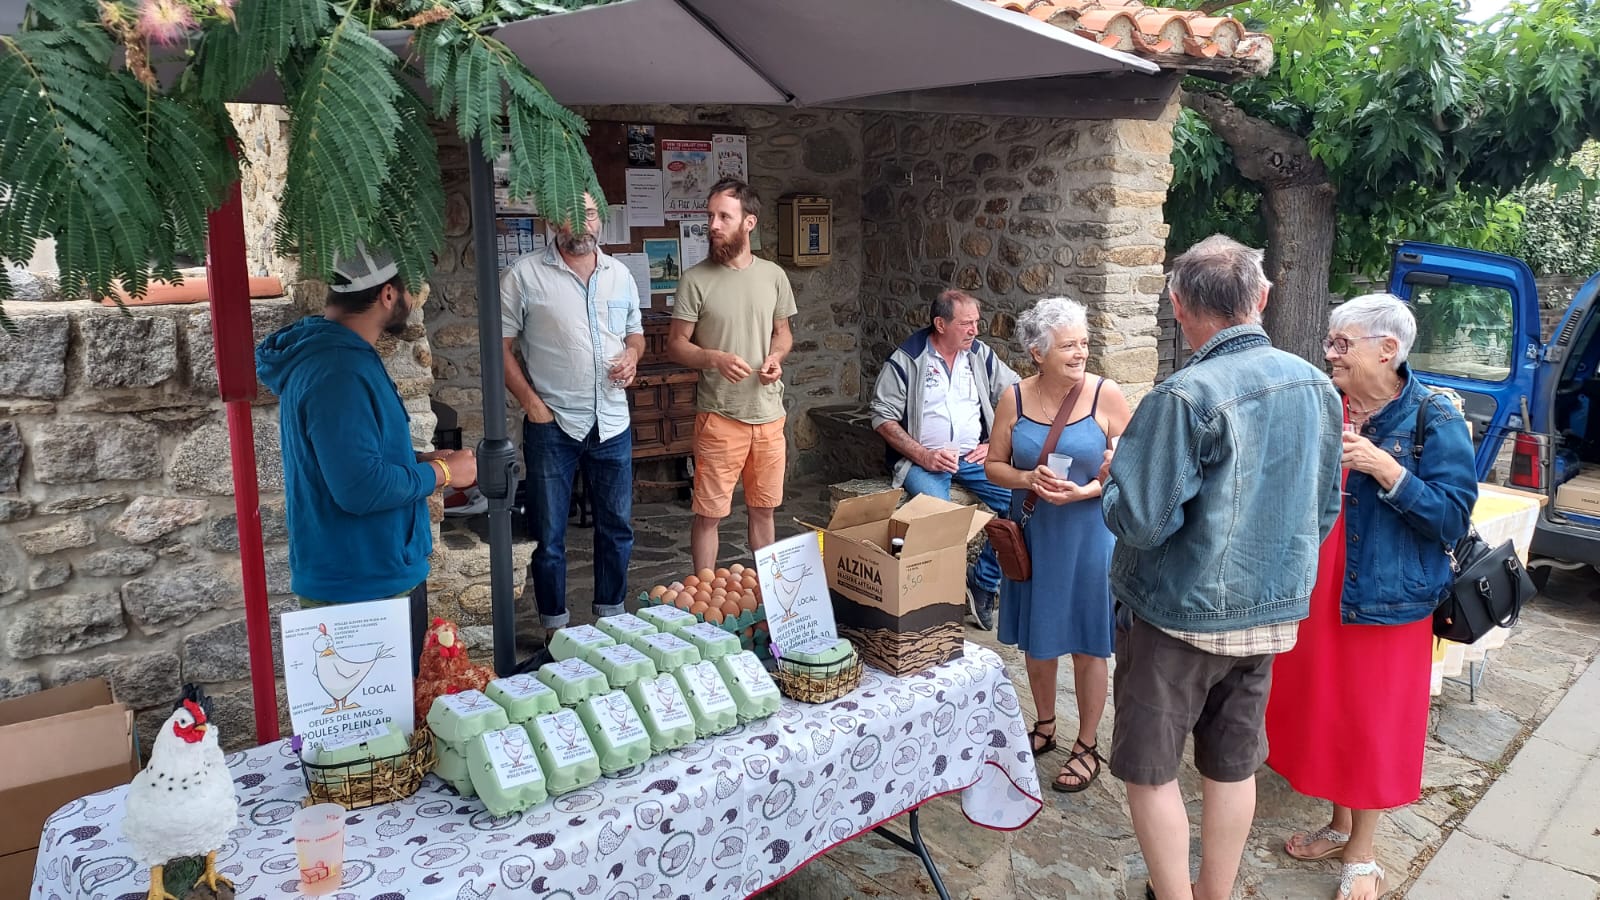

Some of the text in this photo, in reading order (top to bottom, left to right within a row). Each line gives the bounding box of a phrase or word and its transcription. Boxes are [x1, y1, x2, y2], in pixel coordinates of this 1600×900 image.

[837, 555, 882, 585] ALZINA
[797, 595, 817, 606] LOCAL
[791, 623, 806, 635] PLEIN
[807, 619, 818, 629] AIR
[362, 684, 397, 696] LOCAL
[308, 708, 384, 728] OEUFS DEL MASOS
[302, 716, 392, 740] POULES PLEIN AIR
